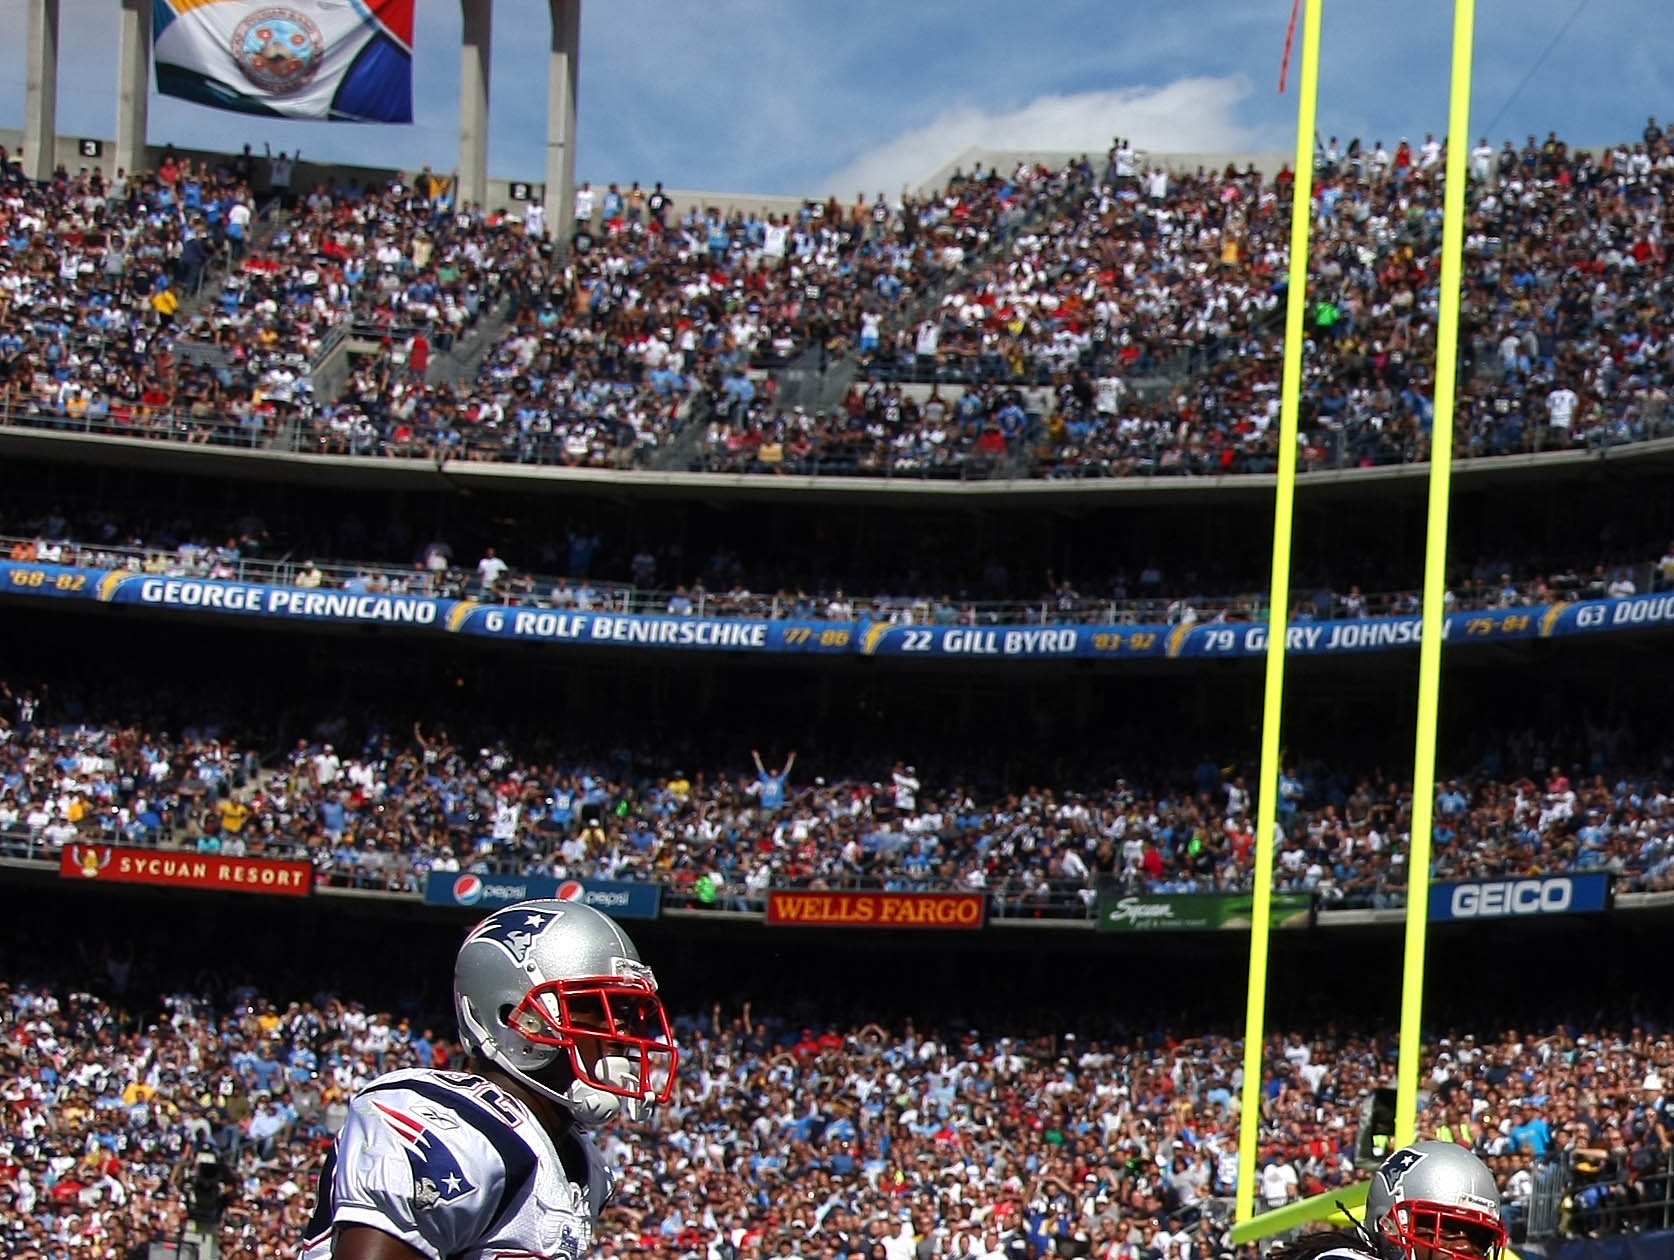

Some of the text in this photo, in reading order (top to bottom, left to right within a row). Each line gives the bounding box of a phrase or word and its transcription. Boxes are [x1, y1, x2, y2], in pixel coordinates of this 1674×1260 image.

[141, 578, 262, 612] GEORGE
[268, 588, 438, 625] PERNICANO
[485, 609, 504, 633] 6
[514, 611, 586, 639] ROLF
[591, 618, 768, 648] BENIRSCHKE
[1577, 605, 1605, 628] 63
[902, 630, 934, 652] 22
[942, 630, 998, 654] GILL
[1003, 628, 1078, 653] BYRD
[1203, 629, 1235, 652] 79
[1244, 625, 1321, 652] GRY
[120, 857, 303, 887] SYCUAN RESORT
[483, 886, 527, 900] pepsi
[585, 890, 629, 905] pepsi
[1451, 878, 1573, 918] GEICO
[775, 896, 978, 923] WELLS FARGO
